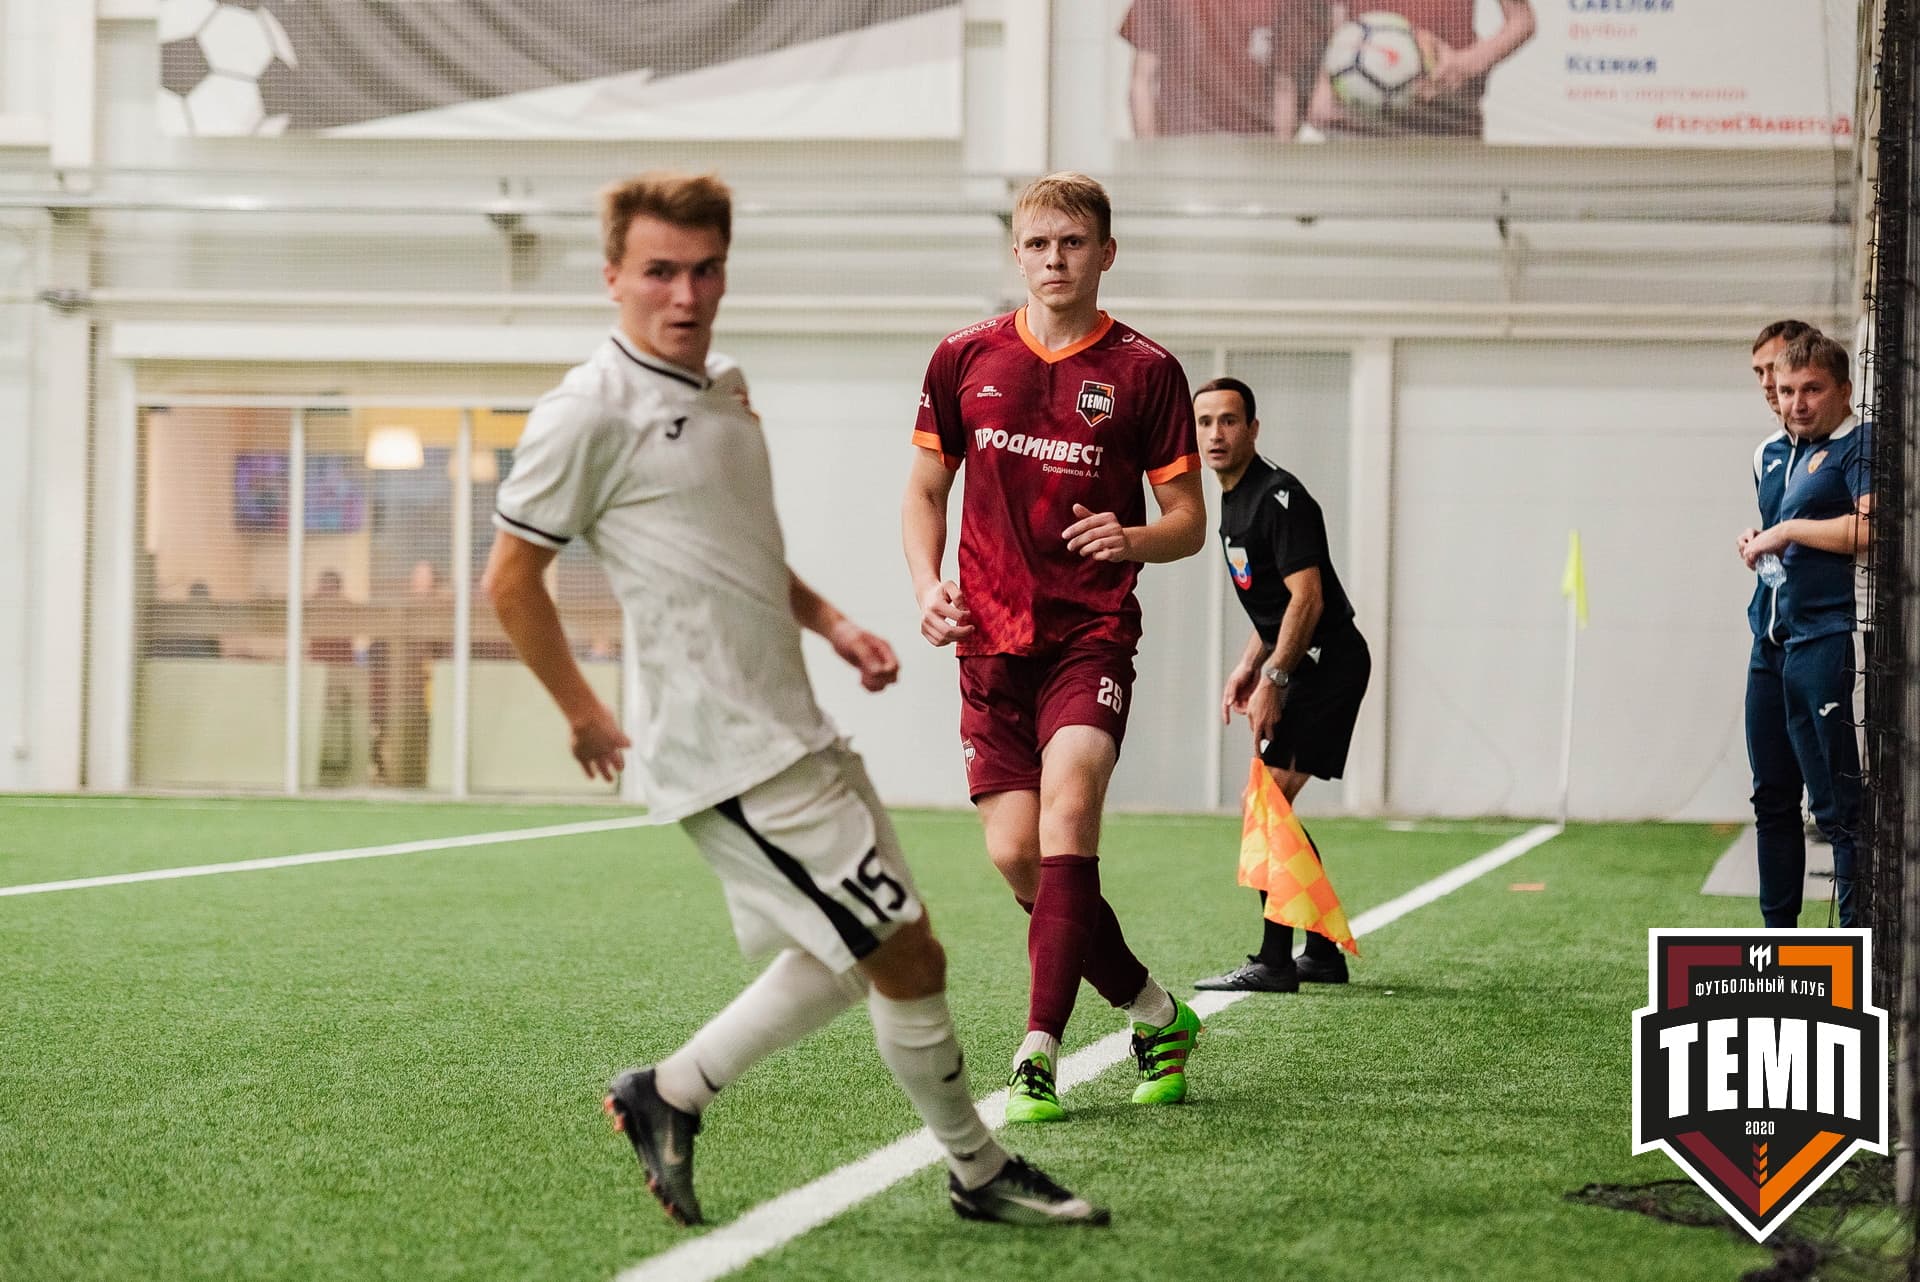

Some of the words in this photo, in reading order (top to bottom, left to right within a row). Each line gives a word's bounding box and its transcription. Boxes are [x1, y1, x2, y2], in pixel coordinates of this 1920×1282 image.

[1081, 393, 1111, 413] ТЕМП
[975, 428, 1104, 466] ПРОДИНВЕСТ
[1042, 463, 1084, 477] Бродников
[1097, 676, 1123, 715] 25
[841, 846, 907, 922] 15
